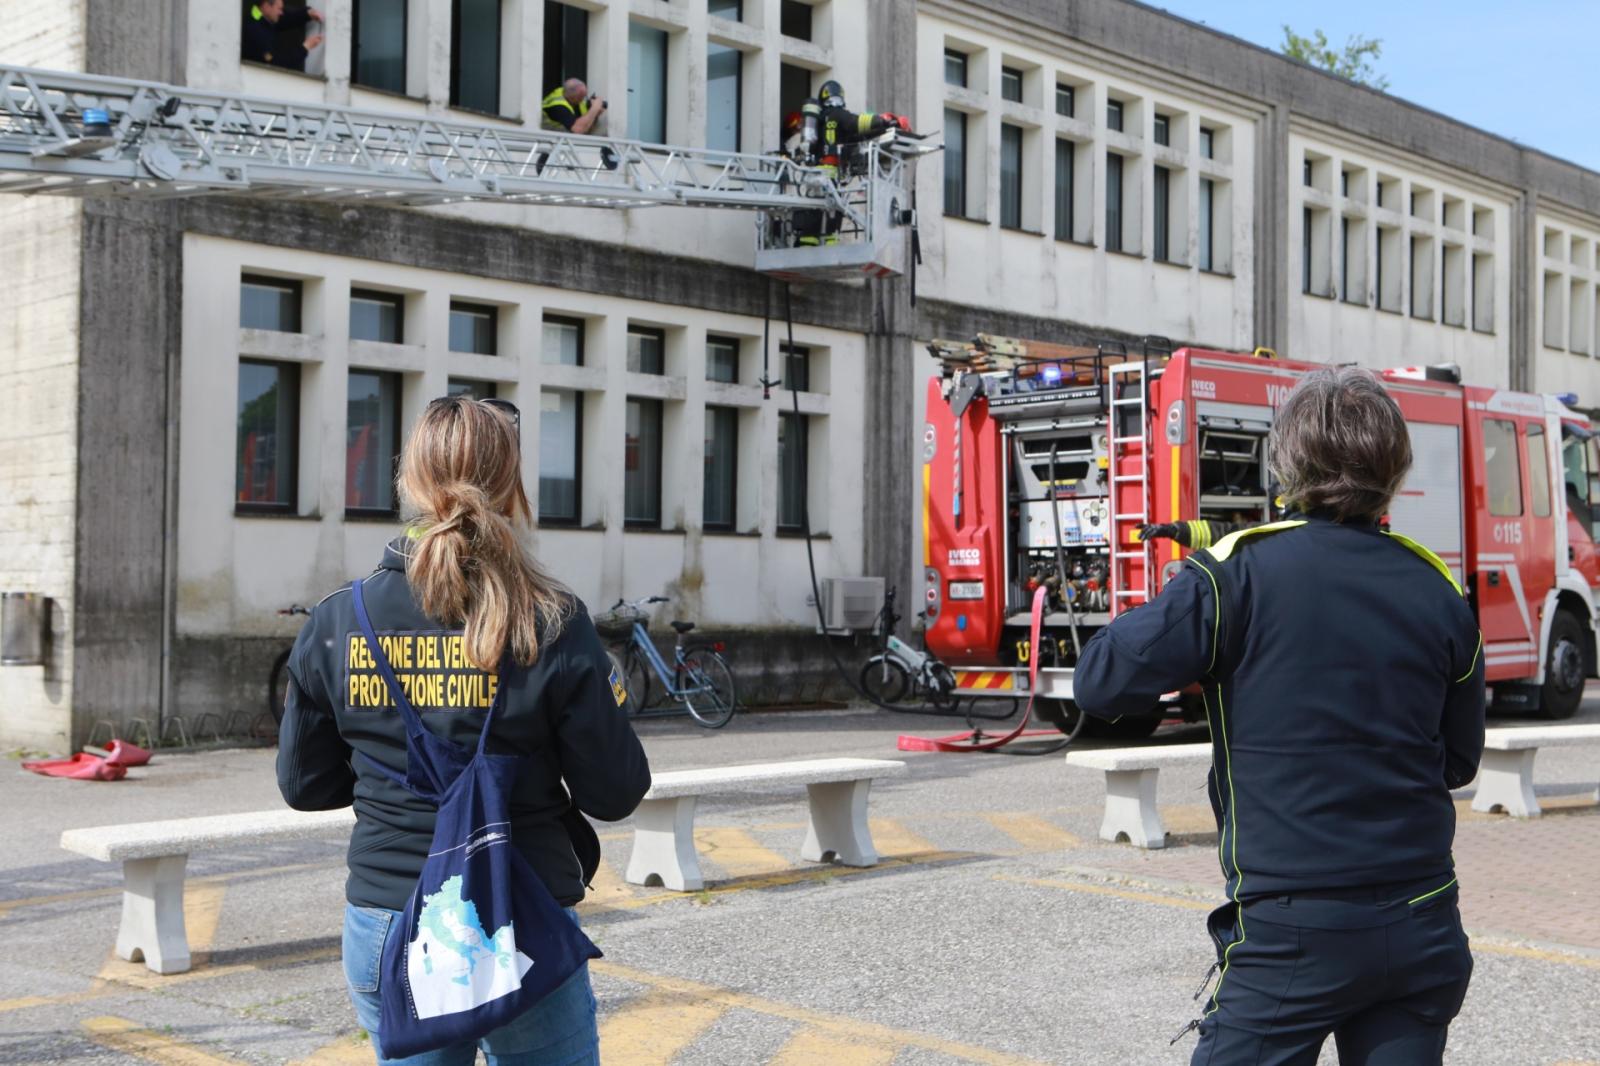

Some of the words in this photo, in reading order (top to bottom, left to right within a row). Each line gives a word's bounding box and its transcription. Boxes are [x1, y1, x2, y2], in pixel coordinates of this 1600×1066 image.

[1192, 380, 1216, 391] IVECO
[1265, 384, 1291, 407] VIG
[949, 548, 980, 559] IVECO
[416, 636, 441, 669] DEL
[442, 636, 477, 669] VEN
[349, 674, 444, 707] PROTZIONE
[447, 674, 498, 707] CIVILE
